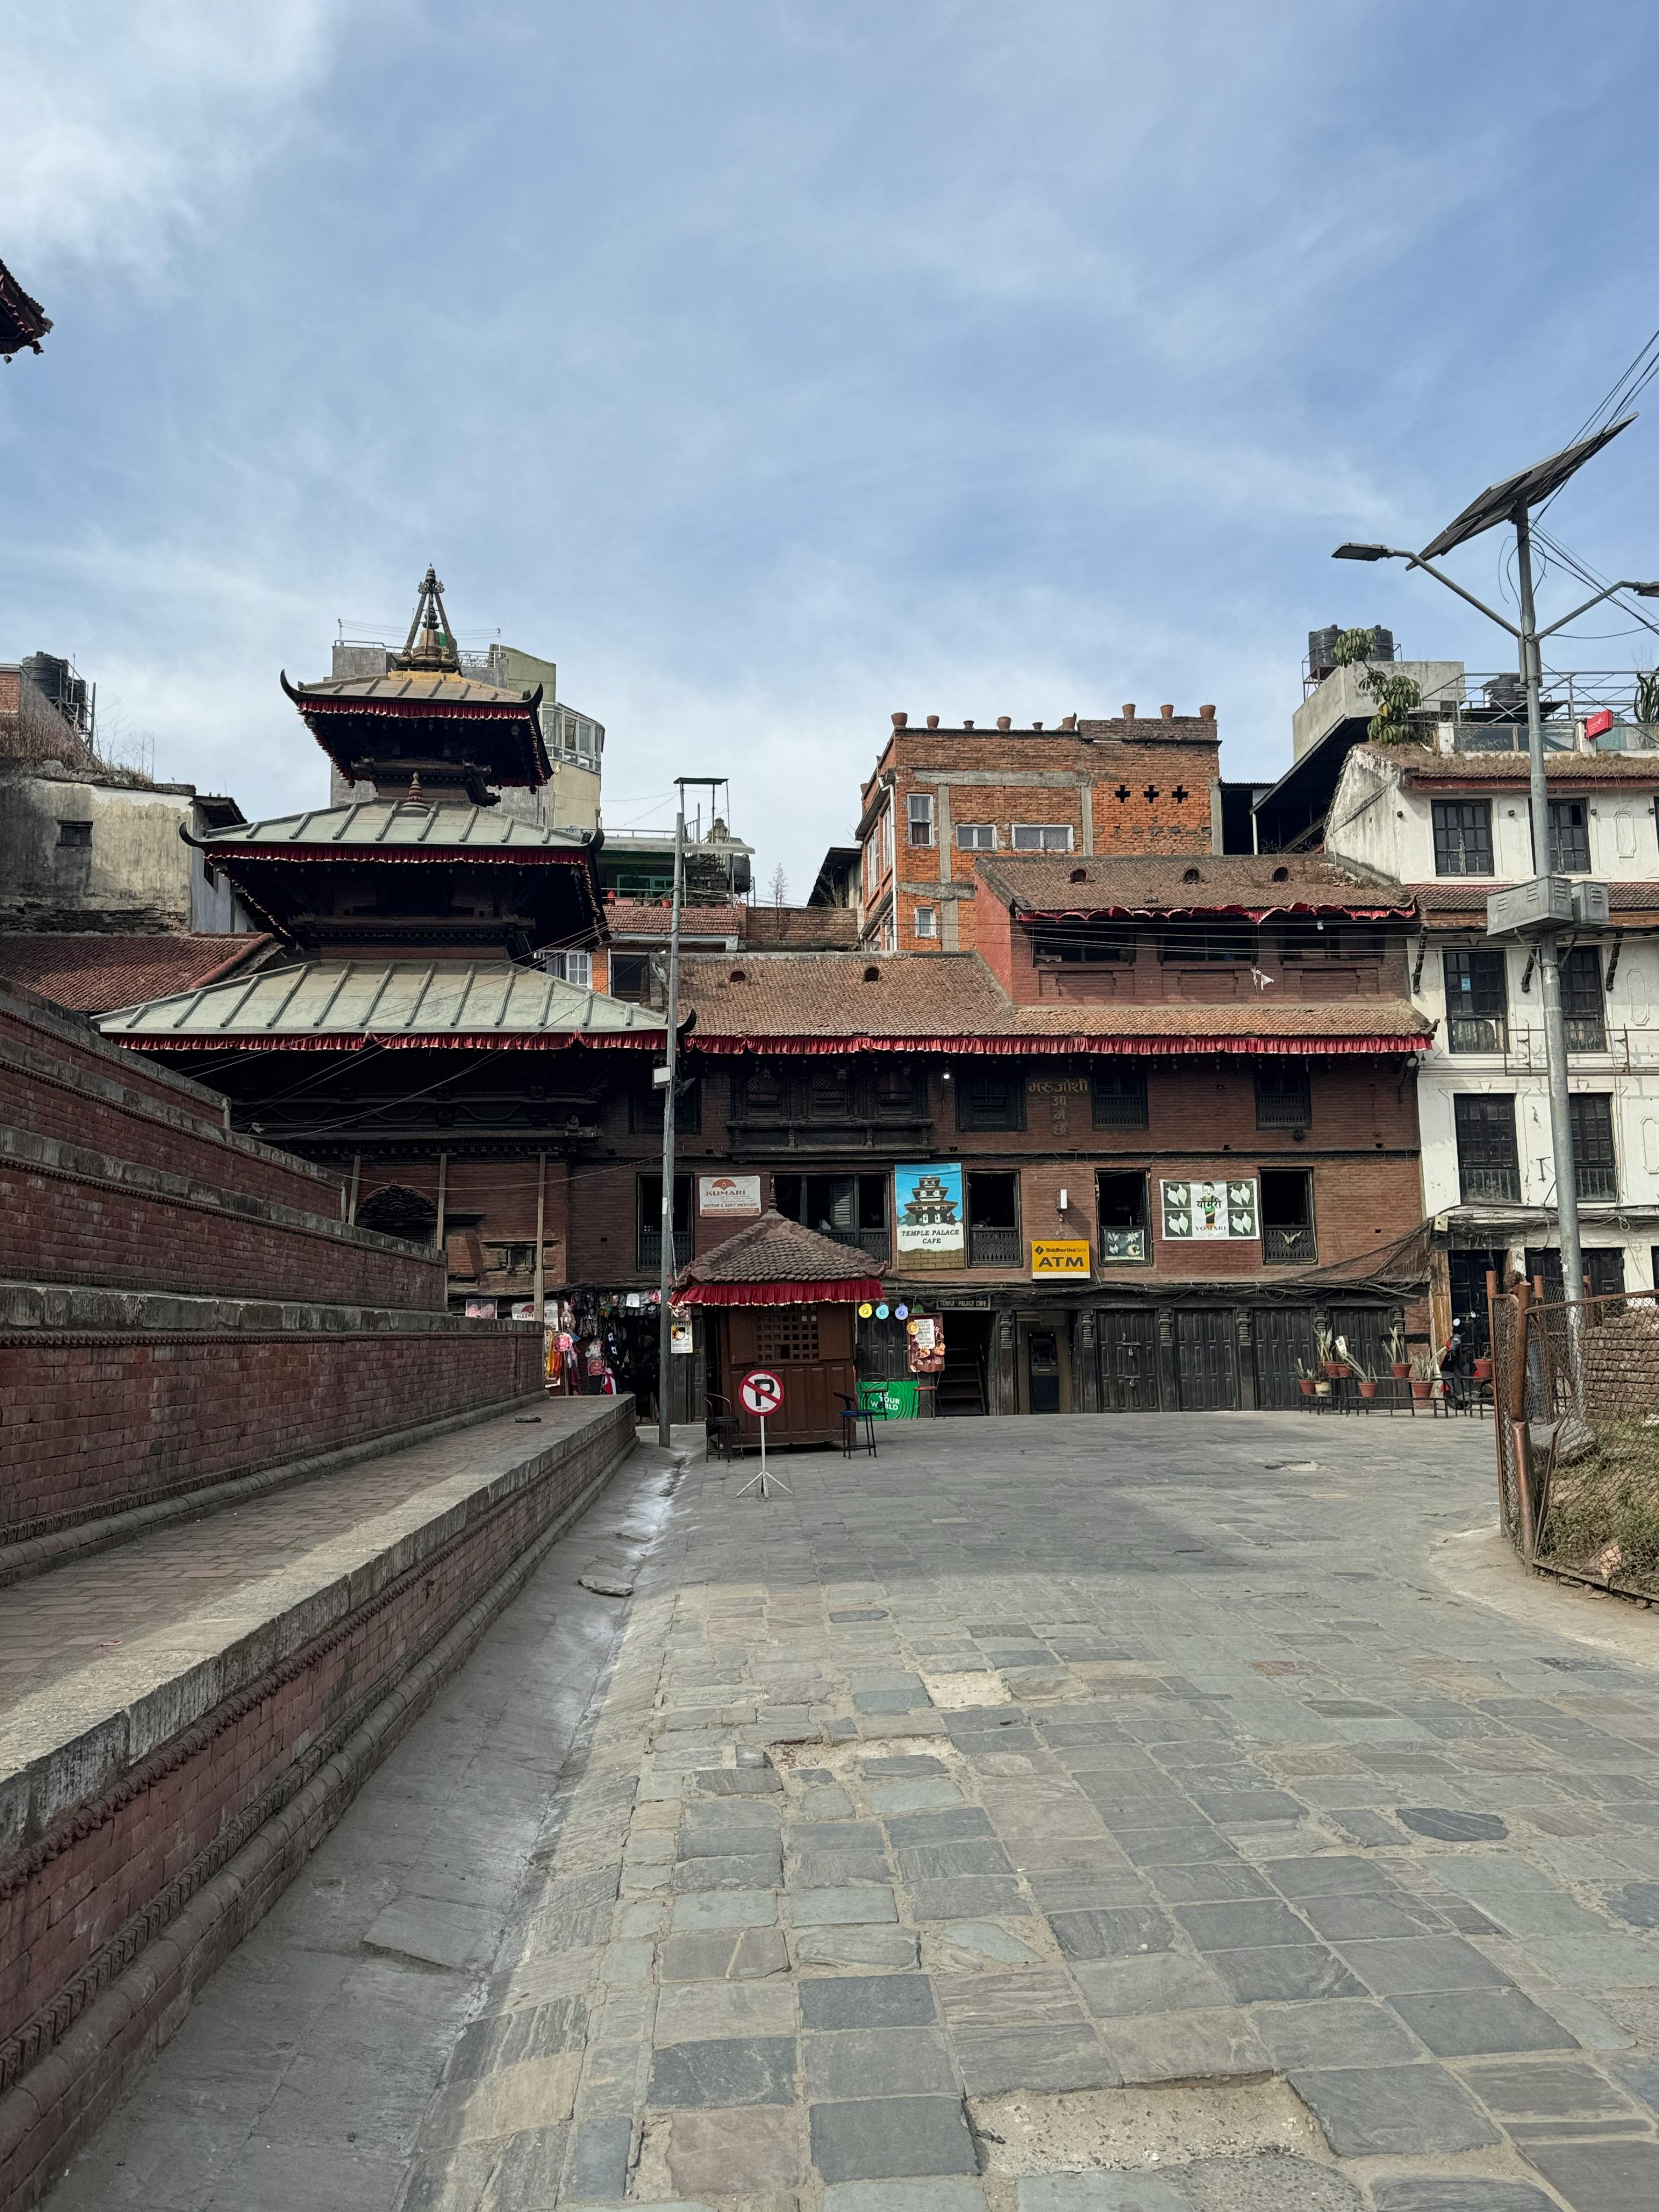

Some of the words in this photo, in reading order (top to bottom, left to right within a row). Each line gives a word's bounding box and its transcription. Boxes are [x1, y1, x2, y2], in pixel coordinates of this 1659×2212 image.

[1038, 1257, 1084, 1267] ATM
[754, 1379, 775, 1407] P
[879, 1395, 900, 1404] YOUR
[871, 1400, 898, 1410] WRLD
